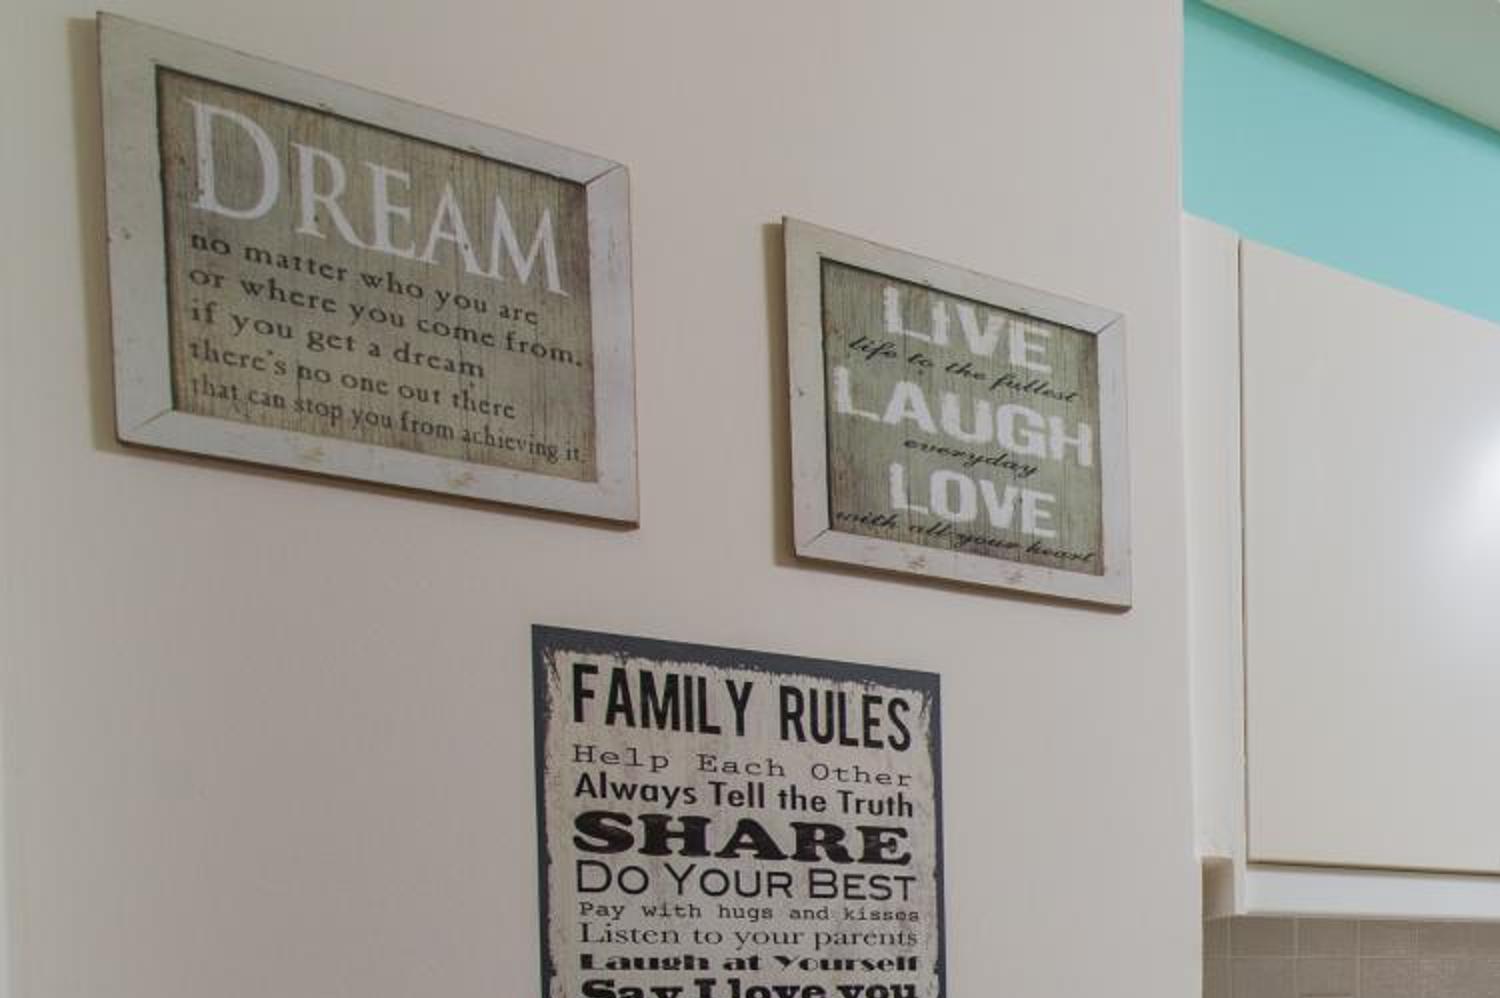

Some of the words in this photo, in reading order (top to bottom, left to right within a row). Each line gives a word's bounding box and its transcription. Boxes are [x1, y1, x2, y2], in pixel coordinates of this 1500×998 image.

[183, 99, 569, 297] DREAM
[189, 268, 226, 289] or
[240, 277, 337, 313] where
[349, 302, 405, 334] you
[416, 316, 495, 347] come
[191, 233, 231, 257] no
[243, 244, 348, 282] matter
[360, 271, 423, 299] who
[435, 287, 488, 319] you
[499, 302, 539, 326] are
[191, 302, 217, 325] if
[231, 313, 293, 347] you
[307, 326, 356, 352] get
[368, 342, 381, 357] a
[393, 339, 485, 377] dream
[882, 285, 1053, 374] LIVE
[190, 340, 288, 377] there's
[297, 364, 332, 384] no
[341, 372, 390, 394] one
[398, 382, 442, 405] out
[452, 383, 516, 420] there
[908, 352, 932, 369] to
[945, 361, 986, 380] the
[990, 375, 1079, 403] fullest
[191, 377, 239, 403] that
[247, 388, 286, 409] can
[294, 394, 343, 422] stop
[351, 404, 394, 432] you
[400, 412, 455, 441] from
[462, 423, 559, 464] achieving
[833, 365, 1094, 466] LAUGH
[904, 439, 1040, 479] everyday
[888, 462, 1057, 538] LOVE
[835, 511, 896, 531] with
[909, 521, 950, 539] all
[955, 531, 1024, 551] your
[1026, 540, 1097, 562] heart
[572, 663, 753, 737] FAMILY
[779, 684, 911, 752] RULES
[573, 744, 669, 771] Help
[698, 753, 786, 778] Each
[811, 763, 913, 787] Other
[574, 773, 697, 809] Always
[709, 781, 765, 809] Tell
[779, 785, 826, 813] the
[837, 790, 913, 818] Truth
[573, 810, 912, 867] SHARE
[579, 901, 625, 920] Pay
[643, 902, 701, 919] with
[718, 903, 773, 920] hugs
[790, 904, 830, 920] and
[844, 905, 920, 922] kisses
[664, 863, 793, 899] YOUR
[809, 868, 916, 901] BEST
[579, 923, 680, 945] Listen
[693, 930, 723, 945] to
[736, 931, 804, 954] your
[815, 930, 918, 950] parents
[579, 953, 709, 971] Laugh
[723, 954, 762, 971] at
[775, 955, 918, 972] Yourself
